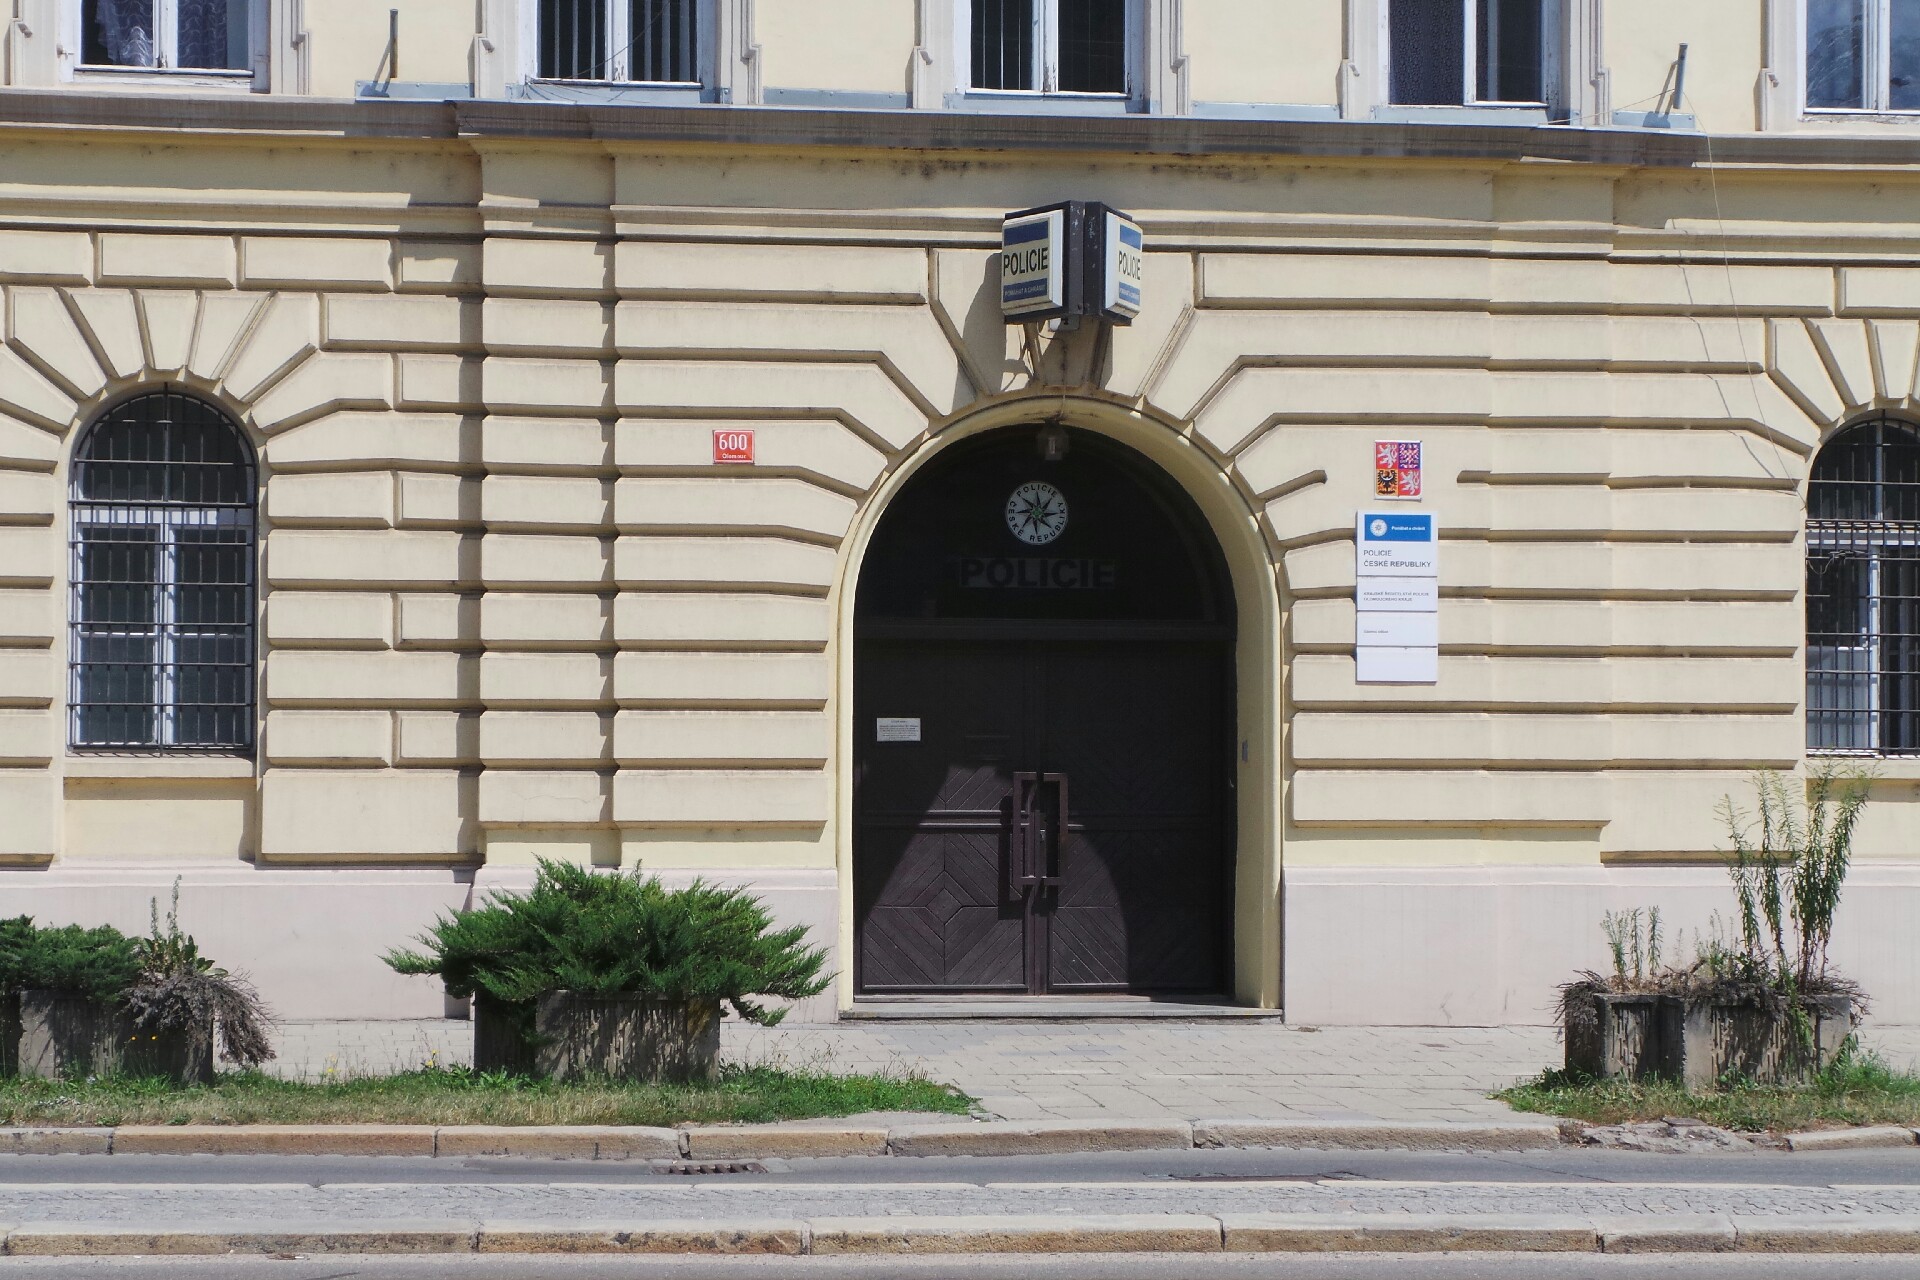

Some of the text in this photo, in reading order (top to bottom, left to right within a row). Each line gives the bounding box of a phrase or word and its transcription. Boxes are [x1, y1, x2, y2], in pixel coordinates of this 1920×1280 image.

[1003, 247, 1048, 277] POLICIE
[1118, 249, 1140, 281] POLICIE
[719, 433, 747, 451] 600
[1016, 484, 1058, 498] POLICIE
[1029, 502, 1066, 543] REPUBLIKY
[1363, 549, 1393, 557] POLICIE
[1363, 559, 1389, 567] ČESKÉ
[960, 558, 1117, 589] POLICIE
